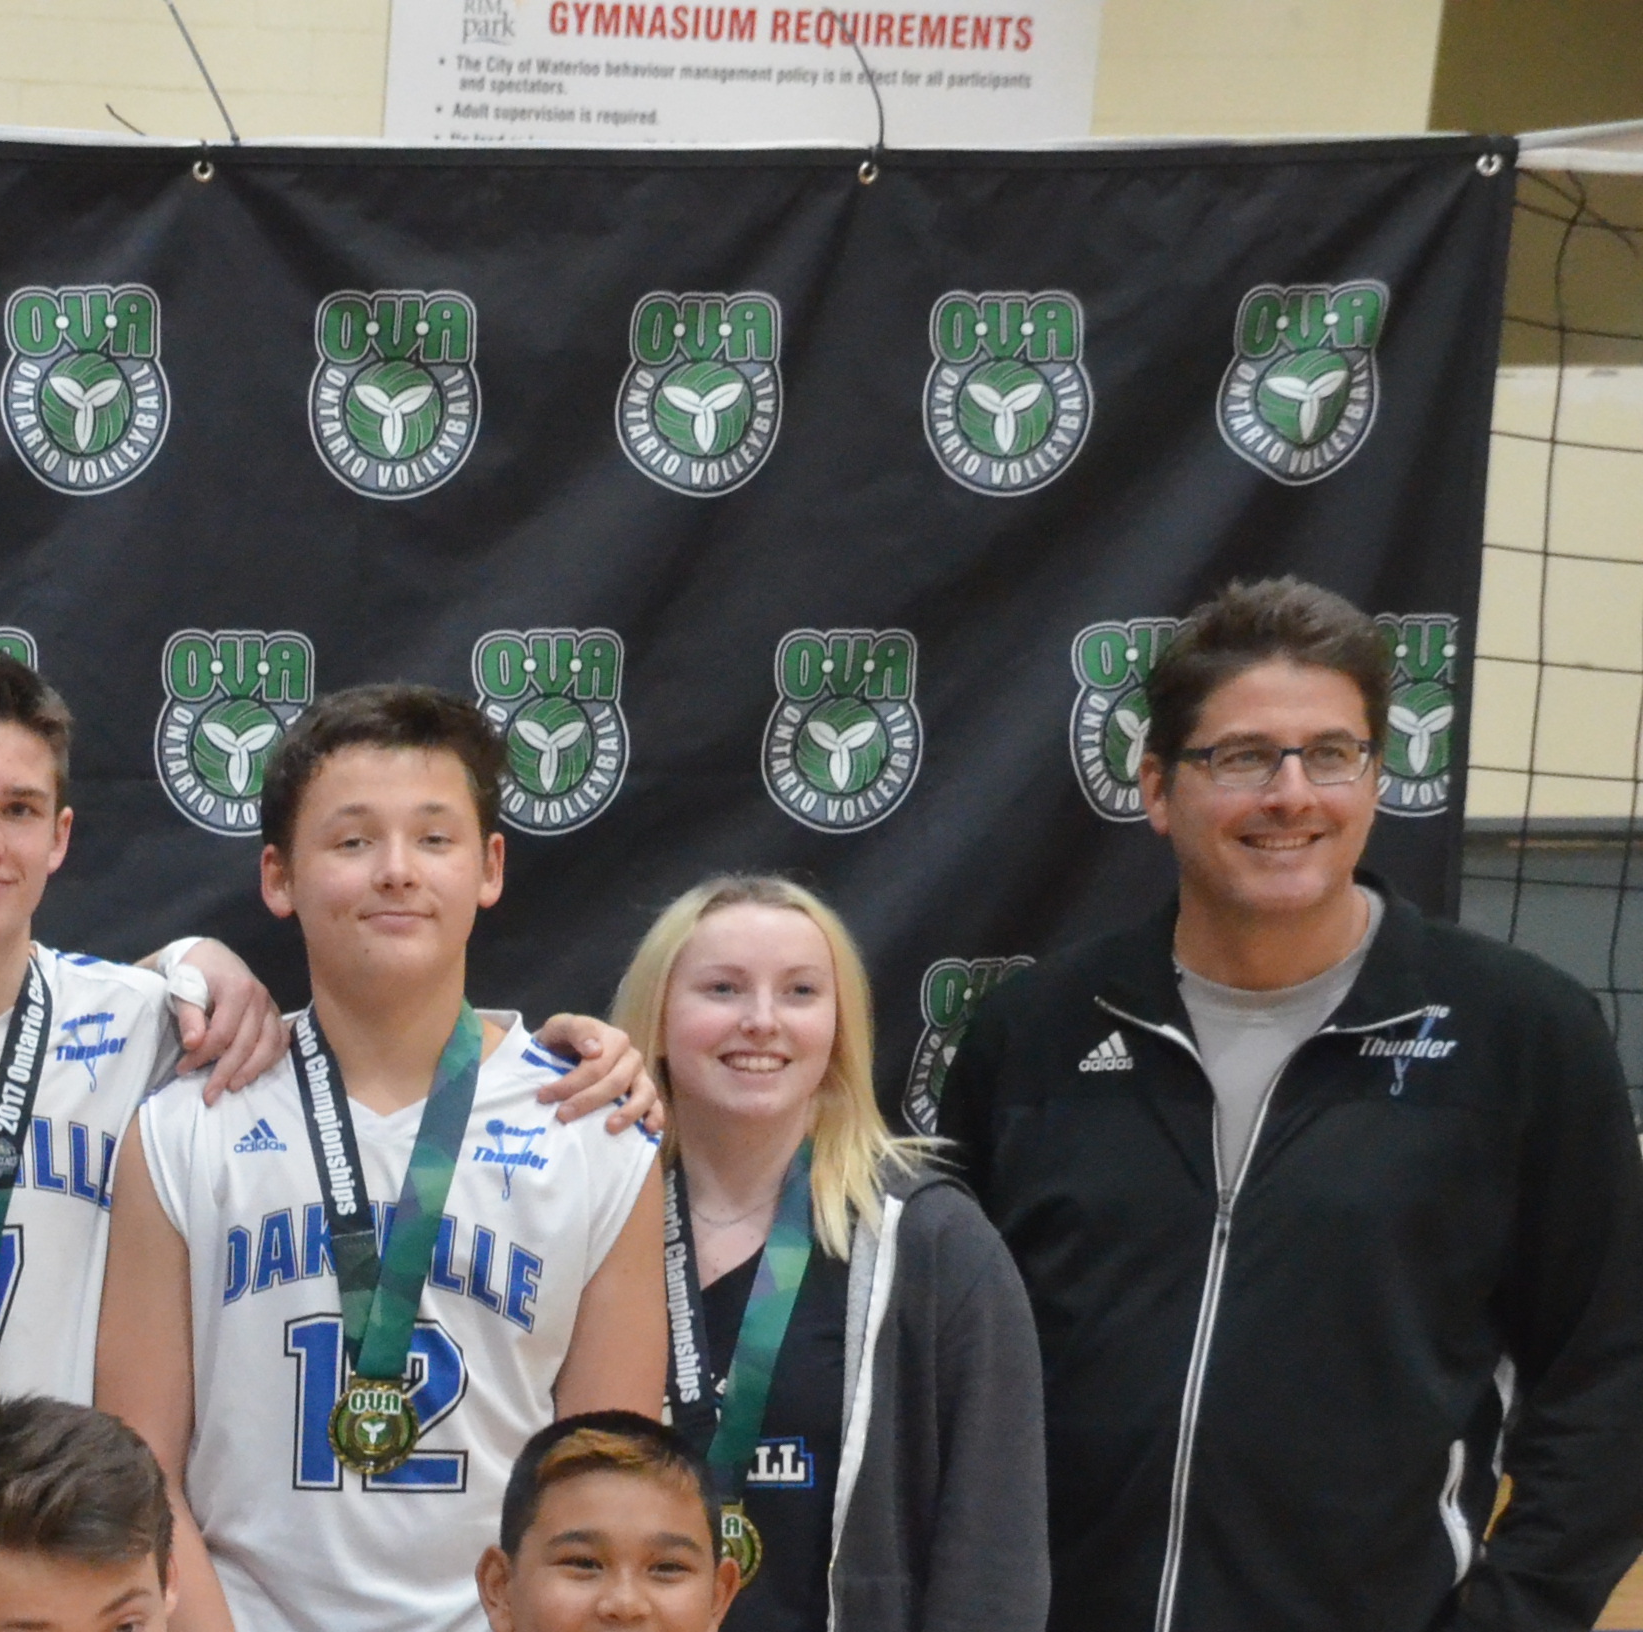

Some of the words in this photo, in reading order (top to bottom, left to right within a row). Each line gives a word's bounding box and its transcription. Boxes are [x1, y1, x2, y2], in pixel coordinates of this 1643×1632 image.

[462, 15, 515, 44] park
[549, 1, 757, 43] GYMNASIUM
[771, 8, 1034, 53] REQUIREMENTS
[457, 55, 481, 72] The
[486, 56, 513, 77] City
[518, 57, 531, 73] of
[535, 58, 599, 76] Waterloo
[605, 61, 675, 79] behaviour
[680, 65, 772, 85] management
[776, 68, 817, 87] policy
[823, 68, 835, 84] is
[839, 68, 852, 84] in
[902, 70, 920, 86] for
[925, 70, 943, 87] all
[947, 71, 1031, 91] participants
[459, 77, 485, 92] and
[490, 78, 568, 96] spectators.
[453, 103, 489, 119] Adult
[493, 104, 575, 123] supervision
[597, 108, 658, 126] required.
[13, 291, 155, 361] OVA
[321, 297, 465, 367] OVA
[628, 298, 766, 367] OVA
[936, 299, 1077, 367] OVA
[1243, 287, 1382, 355] OVA
[9, 361, 65, 472] ONTARIO
[73, 365, 162, 485] VOLLEYBALL
[318, 367, 374, 477] ONTARIO
[382, 370, 471, 490] VOLLEYBALL
[624, 367, 678, 476] ONTARIO
[686, 370, 773, 488] VOLLEYBALL
[932, 367, 988, 475] ONTARIO
[995, 370, 1084, 487] VOLLEYBALL
[1231, 358, 1281, 463] ONTARIO
[1289, 353, 1375, 476] VOLLEYBALL
[172, 640, 310, 701] OVA
[482, 639, 616, 699] OVA
[773, 636, 907, 704] OVA
[164, 705, 214, 814] ONTARIO
[533, 704, 620, 823] VOLLEYBALL
[770, 704, 822, 812] ONTARIO
[829, 707, 913, 824] VOLLEYBALL
[7, 1007, 45, 1086] Ontario
[56, 1036, 127, 1063] Thunder
[1078, 1053, 1134, 1073] adidas
[1359, 1034, 1458, 1061] Thunder
[233, 1138, 287, 1155] adidas
[305, 1052, 357, 1216] Championships
[473, 1146, 548, 1171] Thunder
[223, 1200, 543, 1334] OAKLLE
[664, 1243, 702, 1405] Championships
[283, 1312, 468, 1493] 12
[349, 1389, 402, 1415] OVA
